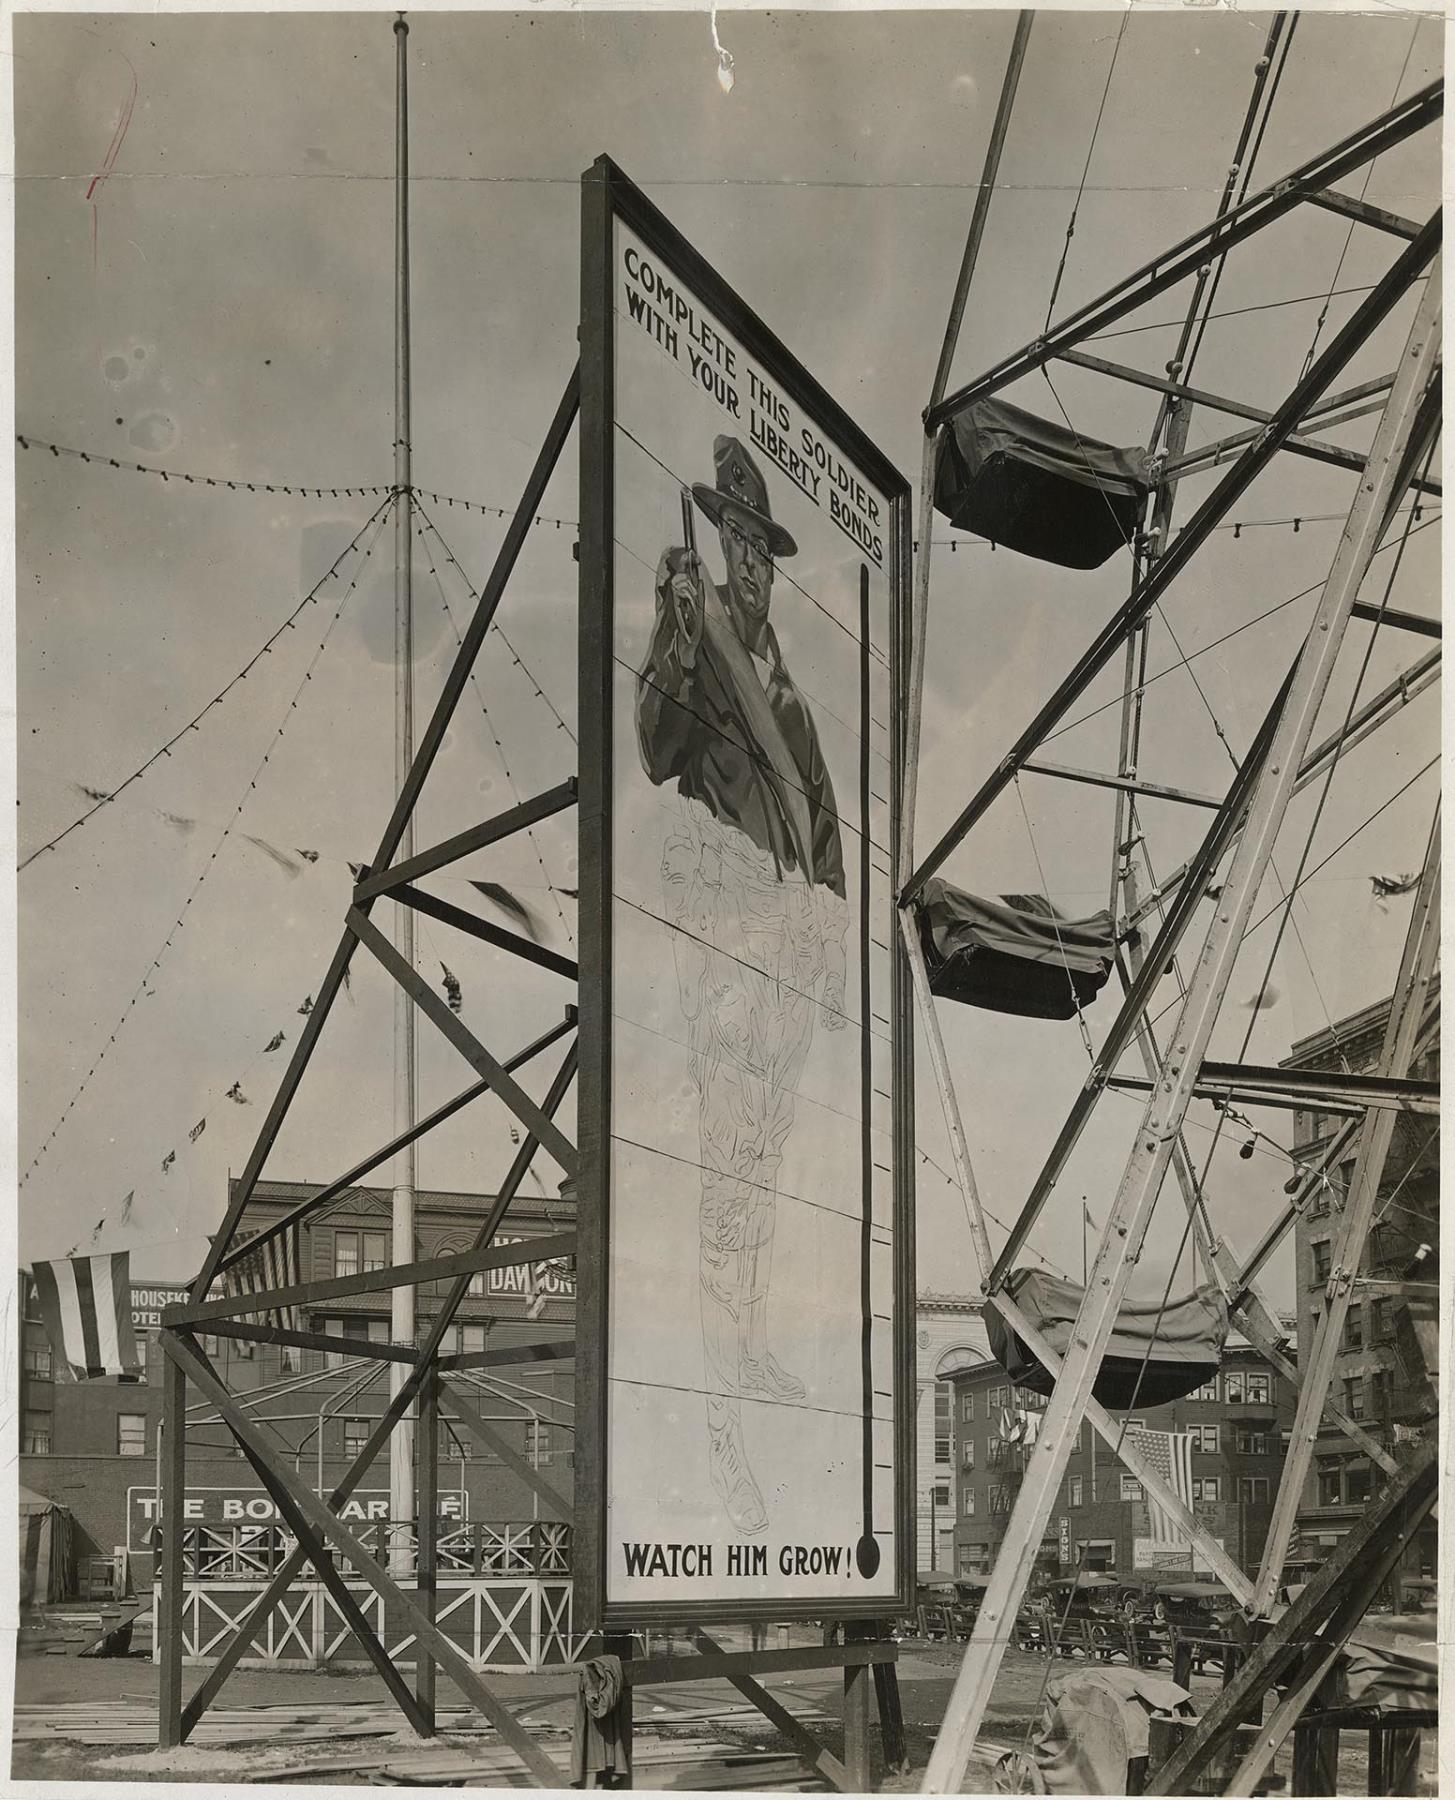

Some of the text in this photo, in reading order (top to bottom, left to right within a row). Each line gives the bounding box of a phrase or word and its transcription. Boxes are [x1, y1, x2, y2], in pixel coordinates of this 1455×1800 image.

[624, 248, 880, 527] COMPLETE THIS SOLDIER
[625, 283, 883, 561] WITH YOUR LIBERTY BONDS
[137, 1498, 205, 1519] TE
[622, 1543, 852, 1579] WATCH HIM GROW!
[1060, 1519, 1069, 1561] SIGNS
